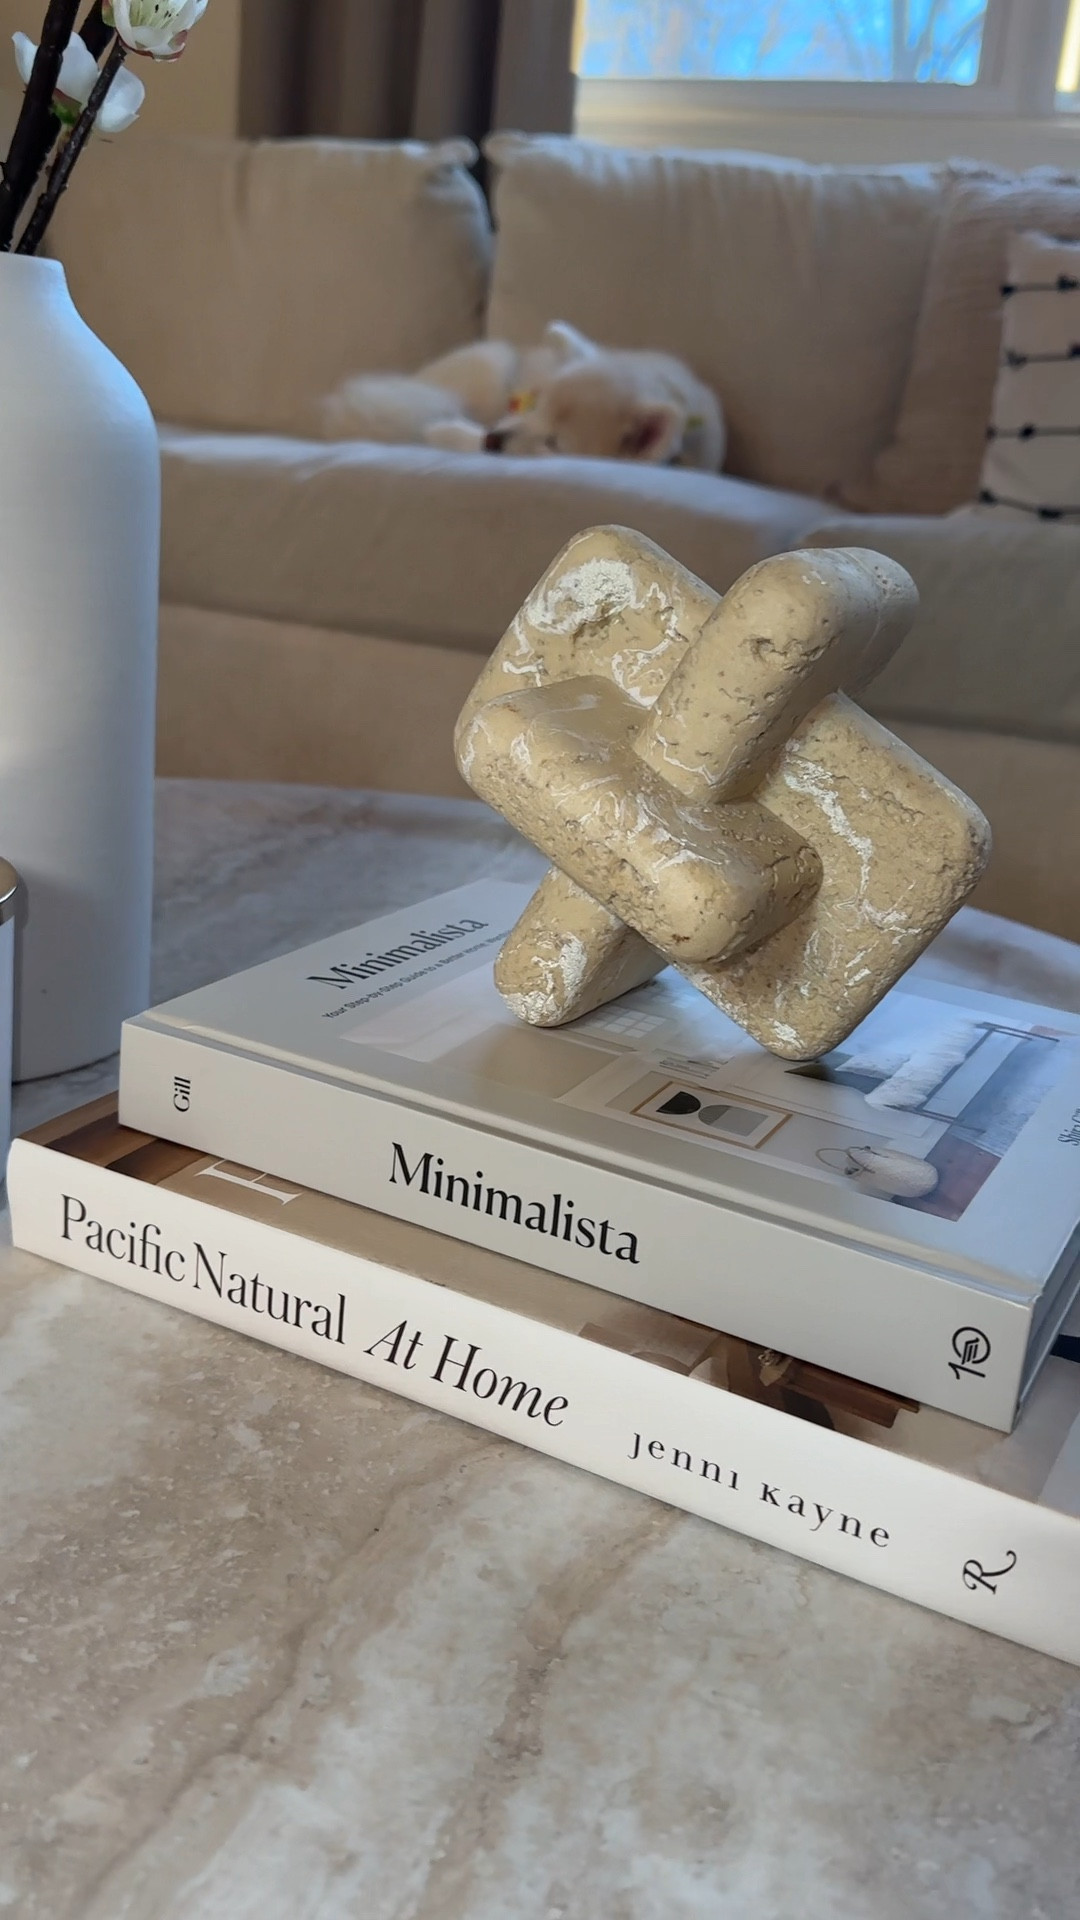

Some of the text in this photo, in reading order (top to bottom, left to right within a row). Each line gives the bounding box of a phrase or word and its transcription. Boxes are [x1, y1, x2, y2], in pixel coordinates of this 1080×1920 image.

[307, 918, 489, 990] Minimalista
[321, 1007, 348, 1018] Your
[173, 1076, 192, 1113] Gill
[388, 1142, 641, 1264] Minimalista
[60, 1193, 570, 1427] Pacific Natural At Home
